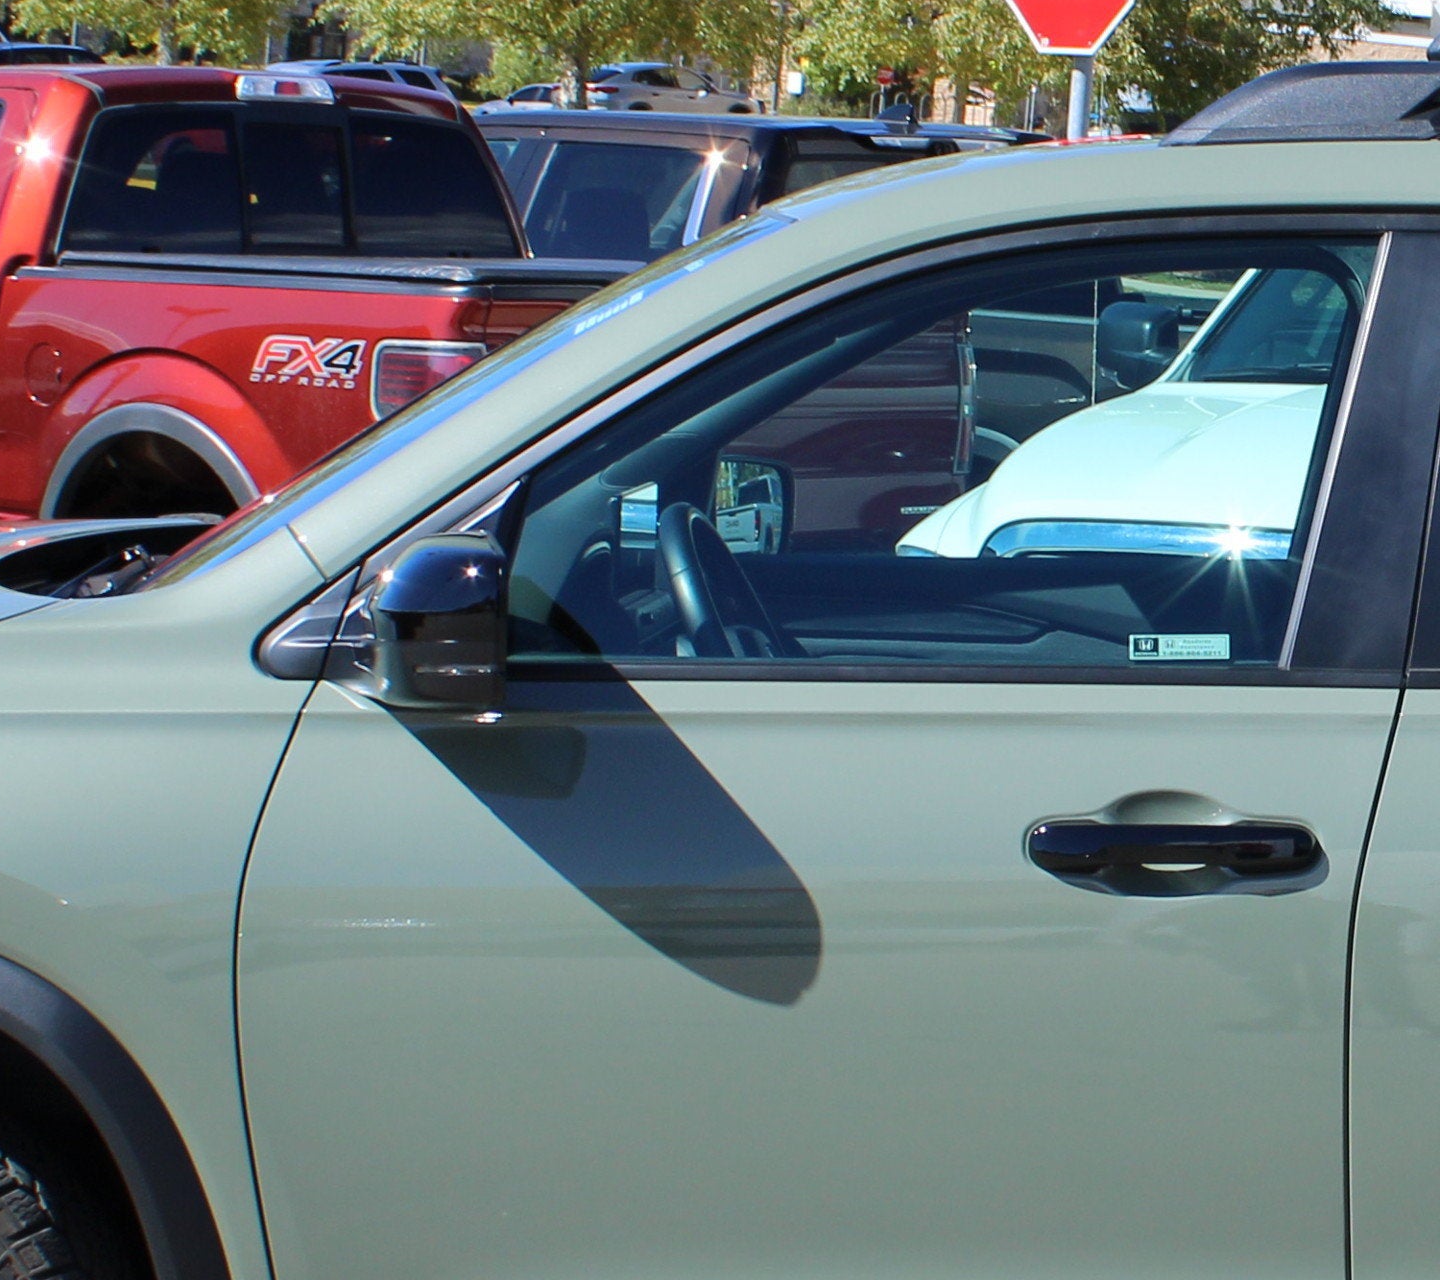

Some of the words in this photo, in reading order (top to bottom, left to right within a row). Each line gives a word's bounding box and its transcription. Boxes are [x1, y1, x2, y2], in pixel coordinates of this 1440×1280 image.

[251, 334, 367, 379] FX4
[249, 373, 288, 384] OFF
[297, 376, 356, 389] ROAD
